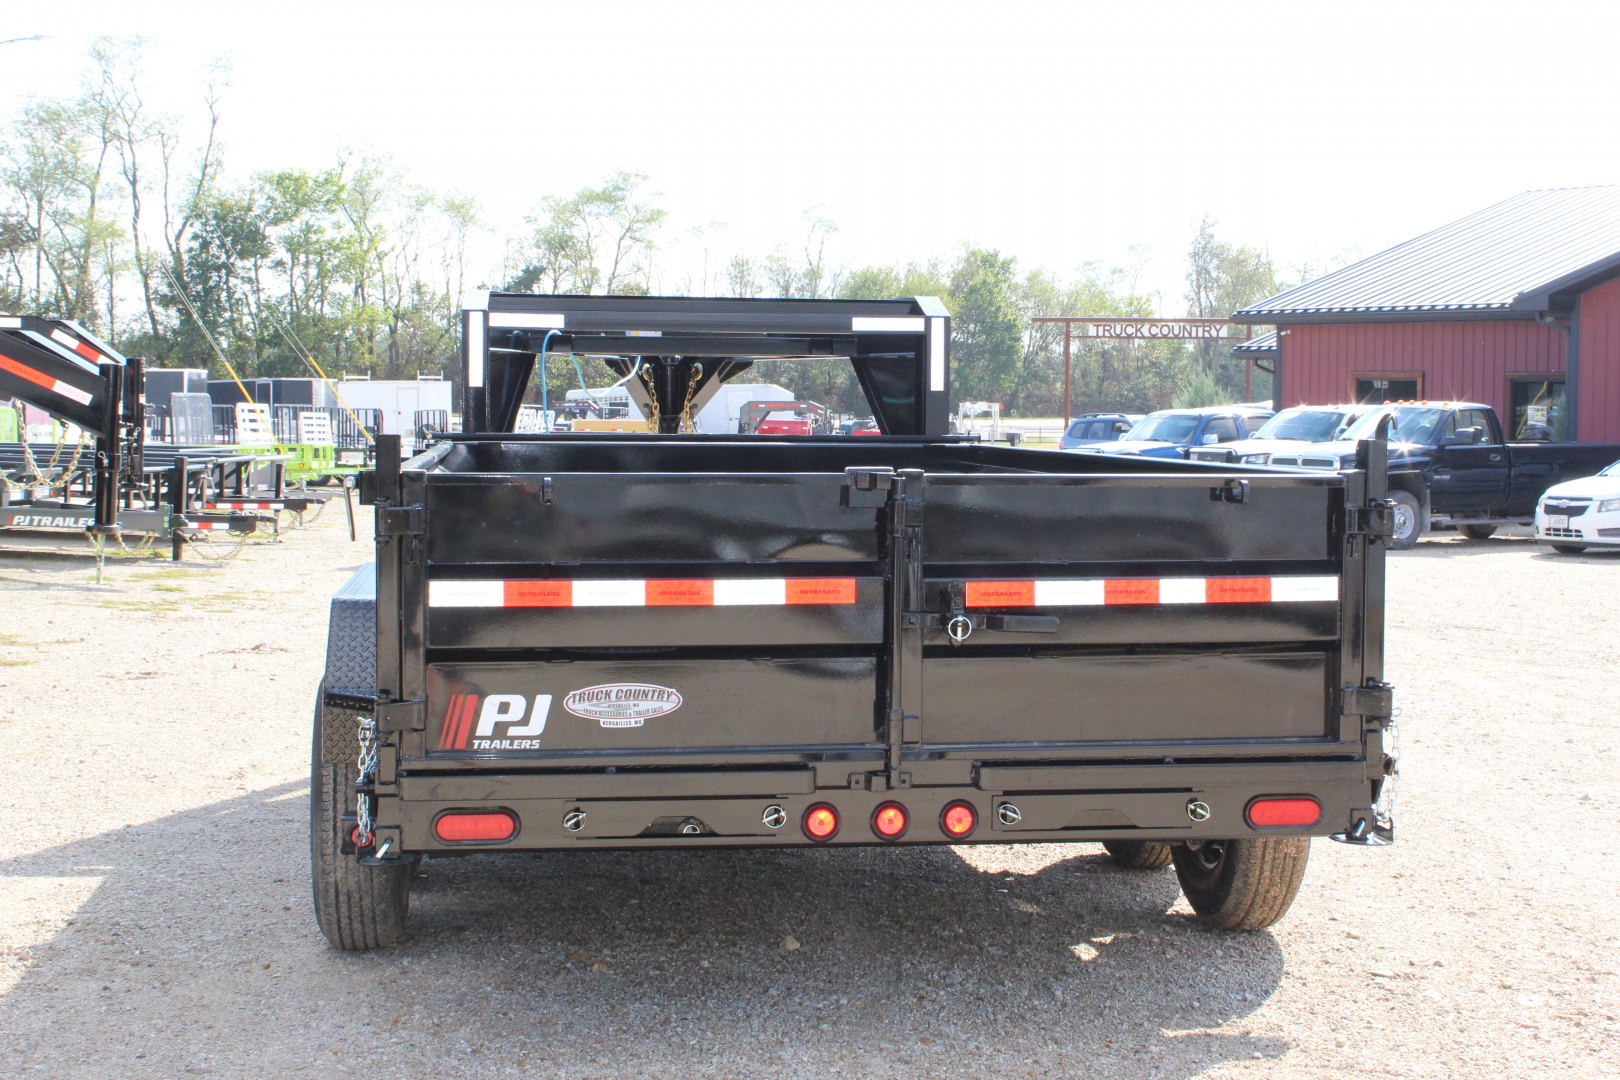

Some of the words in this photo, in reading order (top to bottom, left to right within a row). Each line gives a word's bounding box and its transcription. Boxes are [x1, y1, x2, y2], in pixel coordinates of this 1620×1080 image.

[1093, 324, 1146, 338] TRUCK
[1148, 324, 1223, 338] COUNTRY
[12, 515, 31, 526] PJ
[32, 515, 95, 528] TRAILER
[571, 690, 613, 705] TRUCK
[615, 689, 674, 701] COUNTRY
[475, 694, 553, 736] PJ
[472, 739, 541, 749] TRAILERS
